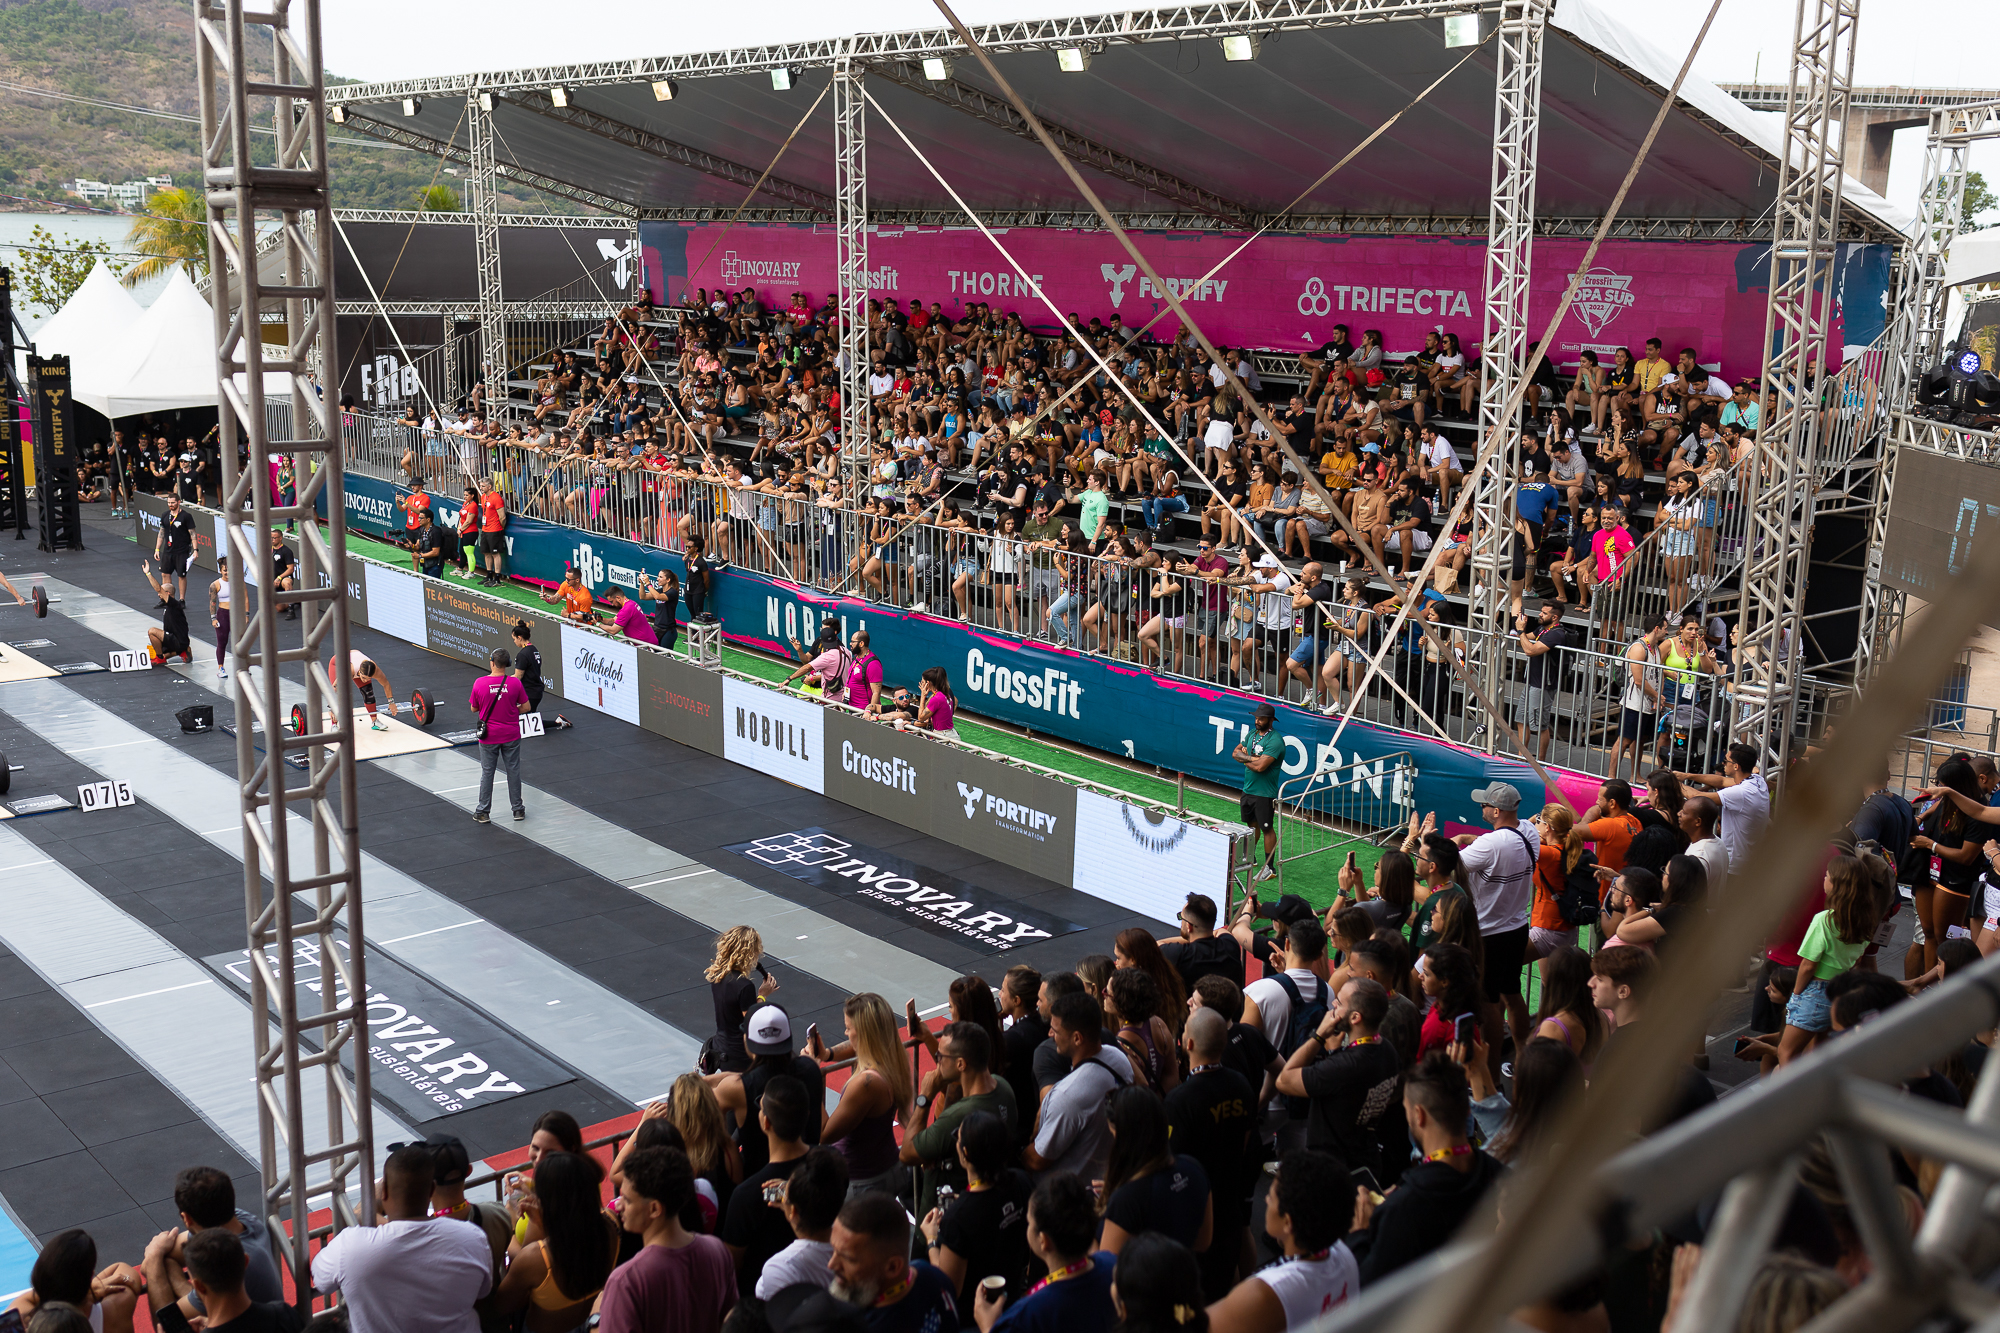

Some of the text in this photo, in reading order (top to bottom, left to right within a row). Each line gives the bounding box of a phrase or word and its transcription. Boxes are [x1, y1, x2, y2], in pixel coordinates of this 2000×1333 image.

[742, 260, 801, 278] INOVARY
[1585, 276, 1613, 286] CrossFit
[947, 270, 1044, 298] THORNE
[1604, 289, 1635, 307] SUR
[1333, 285, 1472, 318] TRIFECTA
[41, 366, 66, 376] KING
[54, 407, 65, 456] FORTIFY
[344, 491, 393, 519] INOVARY
[318, 571, 361, 600] THNE
[610, 568, 634, 584] CrossFit
[425, 587, 436, 601] TE
[437, 591, 443, 603] 4
[472, 602, 500, 622] Snatch
[112, 652, 148, 669] 070
[574, 647, 624, 683] Michelob
[584, 672, 617, 691] ULTRA
[966, 647, 1084, 720] CrossFit
[665, 690, 711, 717] INOVARY
[736, 706, 809, 762] NOBULL
[842, 739, 917, 795] CrossFit
[1208, 715, 1419, 809] TORNE
[82, 783, 130, 807] 075
[985, 793, 1057, 835] FORTIFY
[995, 819, 1045, 842] TRANSFORMATION
[823, 858, 1053, 943] INOVARY
[857, 887, 1013, 950] pisos sustentáveis
[368, 1045, 464, 1112] sustentáveis
[1210, 1099, 1248, 1123] YES.
